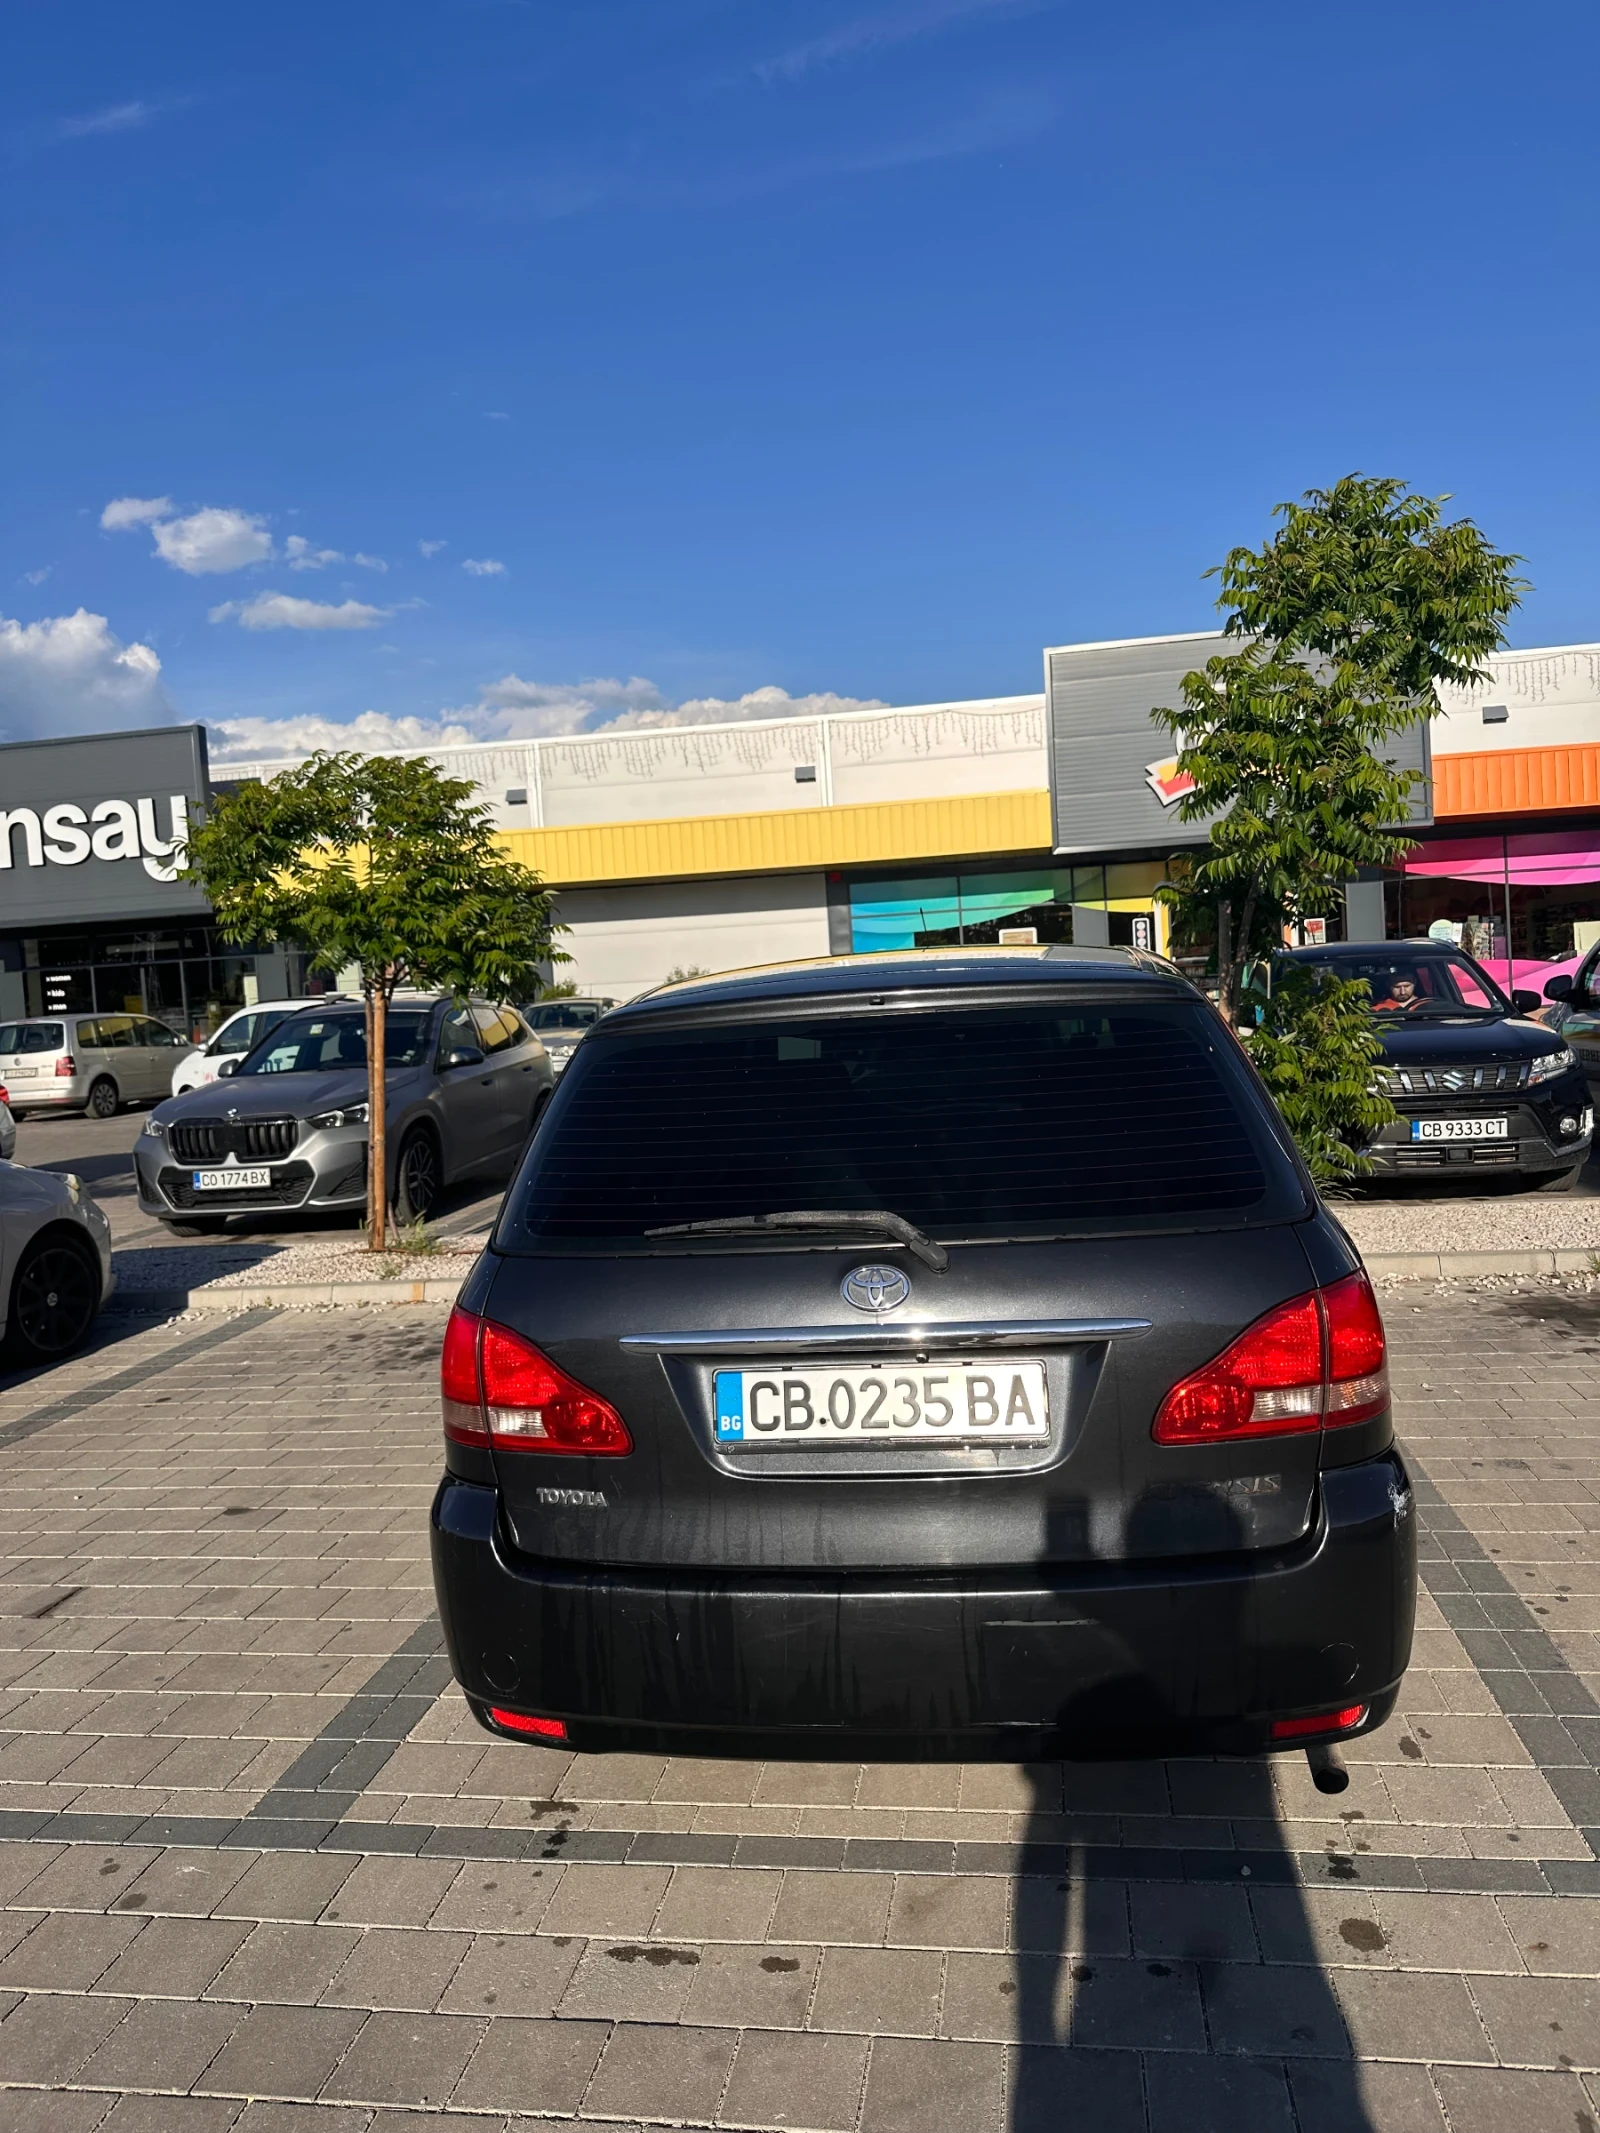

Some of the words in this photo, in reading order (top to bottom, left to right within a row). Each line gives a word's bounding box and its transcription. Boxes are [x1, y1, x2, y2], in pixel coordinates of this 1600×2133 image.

[0, 795, 189, 882] nsay
[51, 989, 66, 997] kids
[1422, 1123, 1442, 1137] CB
[1446, 1122, 1482, 1137] 9333
[1485, 1120, 1505, 1135] CT
[202, 1173, 218, 1187] CO
[221, 1172, 248, 1186] 1774
[250, 1171, 267, 1184] BX
[749, 1379, 815, 1432] CB
[828, 1375, 954, 1430] 0235
[966, 1374, 1036, 1427] BA
[721, 1415, 742, 1431] BG
[536, 1487, 608, 1507] TOYOTA
